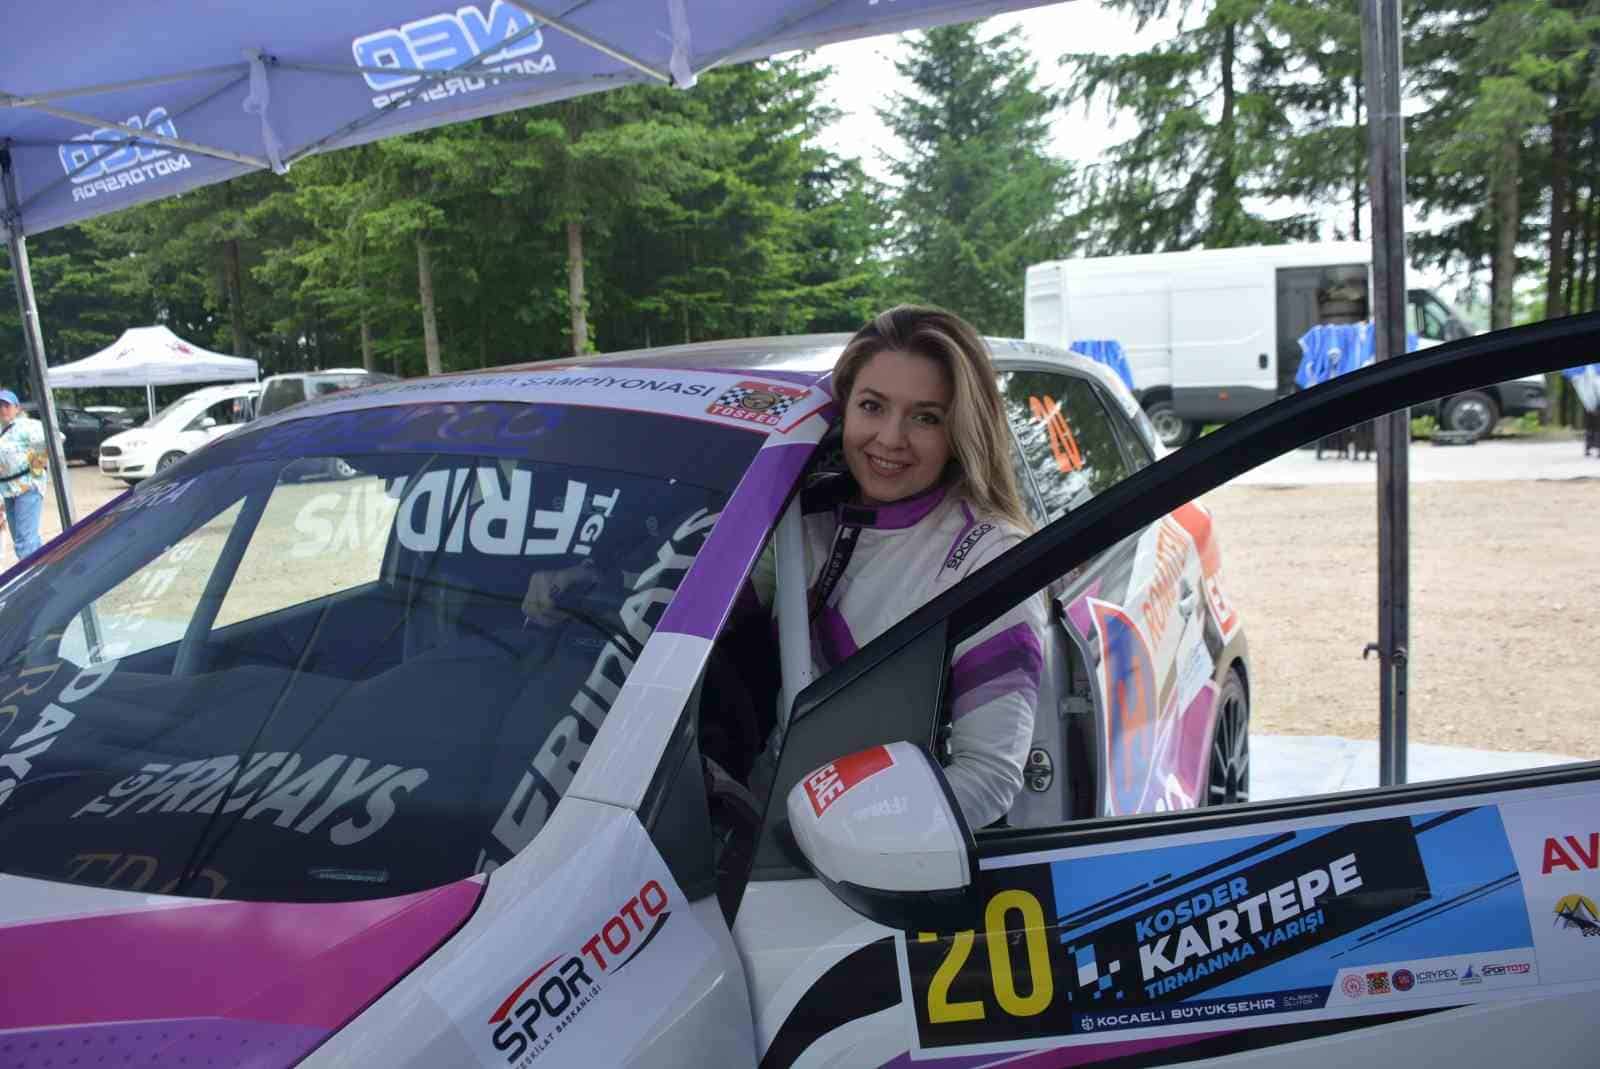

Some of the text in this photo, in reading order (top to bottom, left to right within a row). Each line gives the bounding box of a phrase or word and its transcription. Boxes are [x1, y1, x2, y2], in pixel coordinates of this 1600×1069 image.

[710, 405, 781, 426] TOSFED
[946, 523, 997, 572] sparco
[104, 751, 430, 847] FRIDAYS
[809, 764, 846, 809] EAE
[1135, 876, 1249, 943] KOSDER
[1138, 852, 1364, 982] KARTEPE
[918, 889, 1055, 1024] 20
[1145, 909, 1325, 1000] TIRMANMA YARIŞI
[1096, 1008, 1165, 1028] KOCAELİ
[1170, 997, 1277, 1018] BÜYÜKŞEHİR
